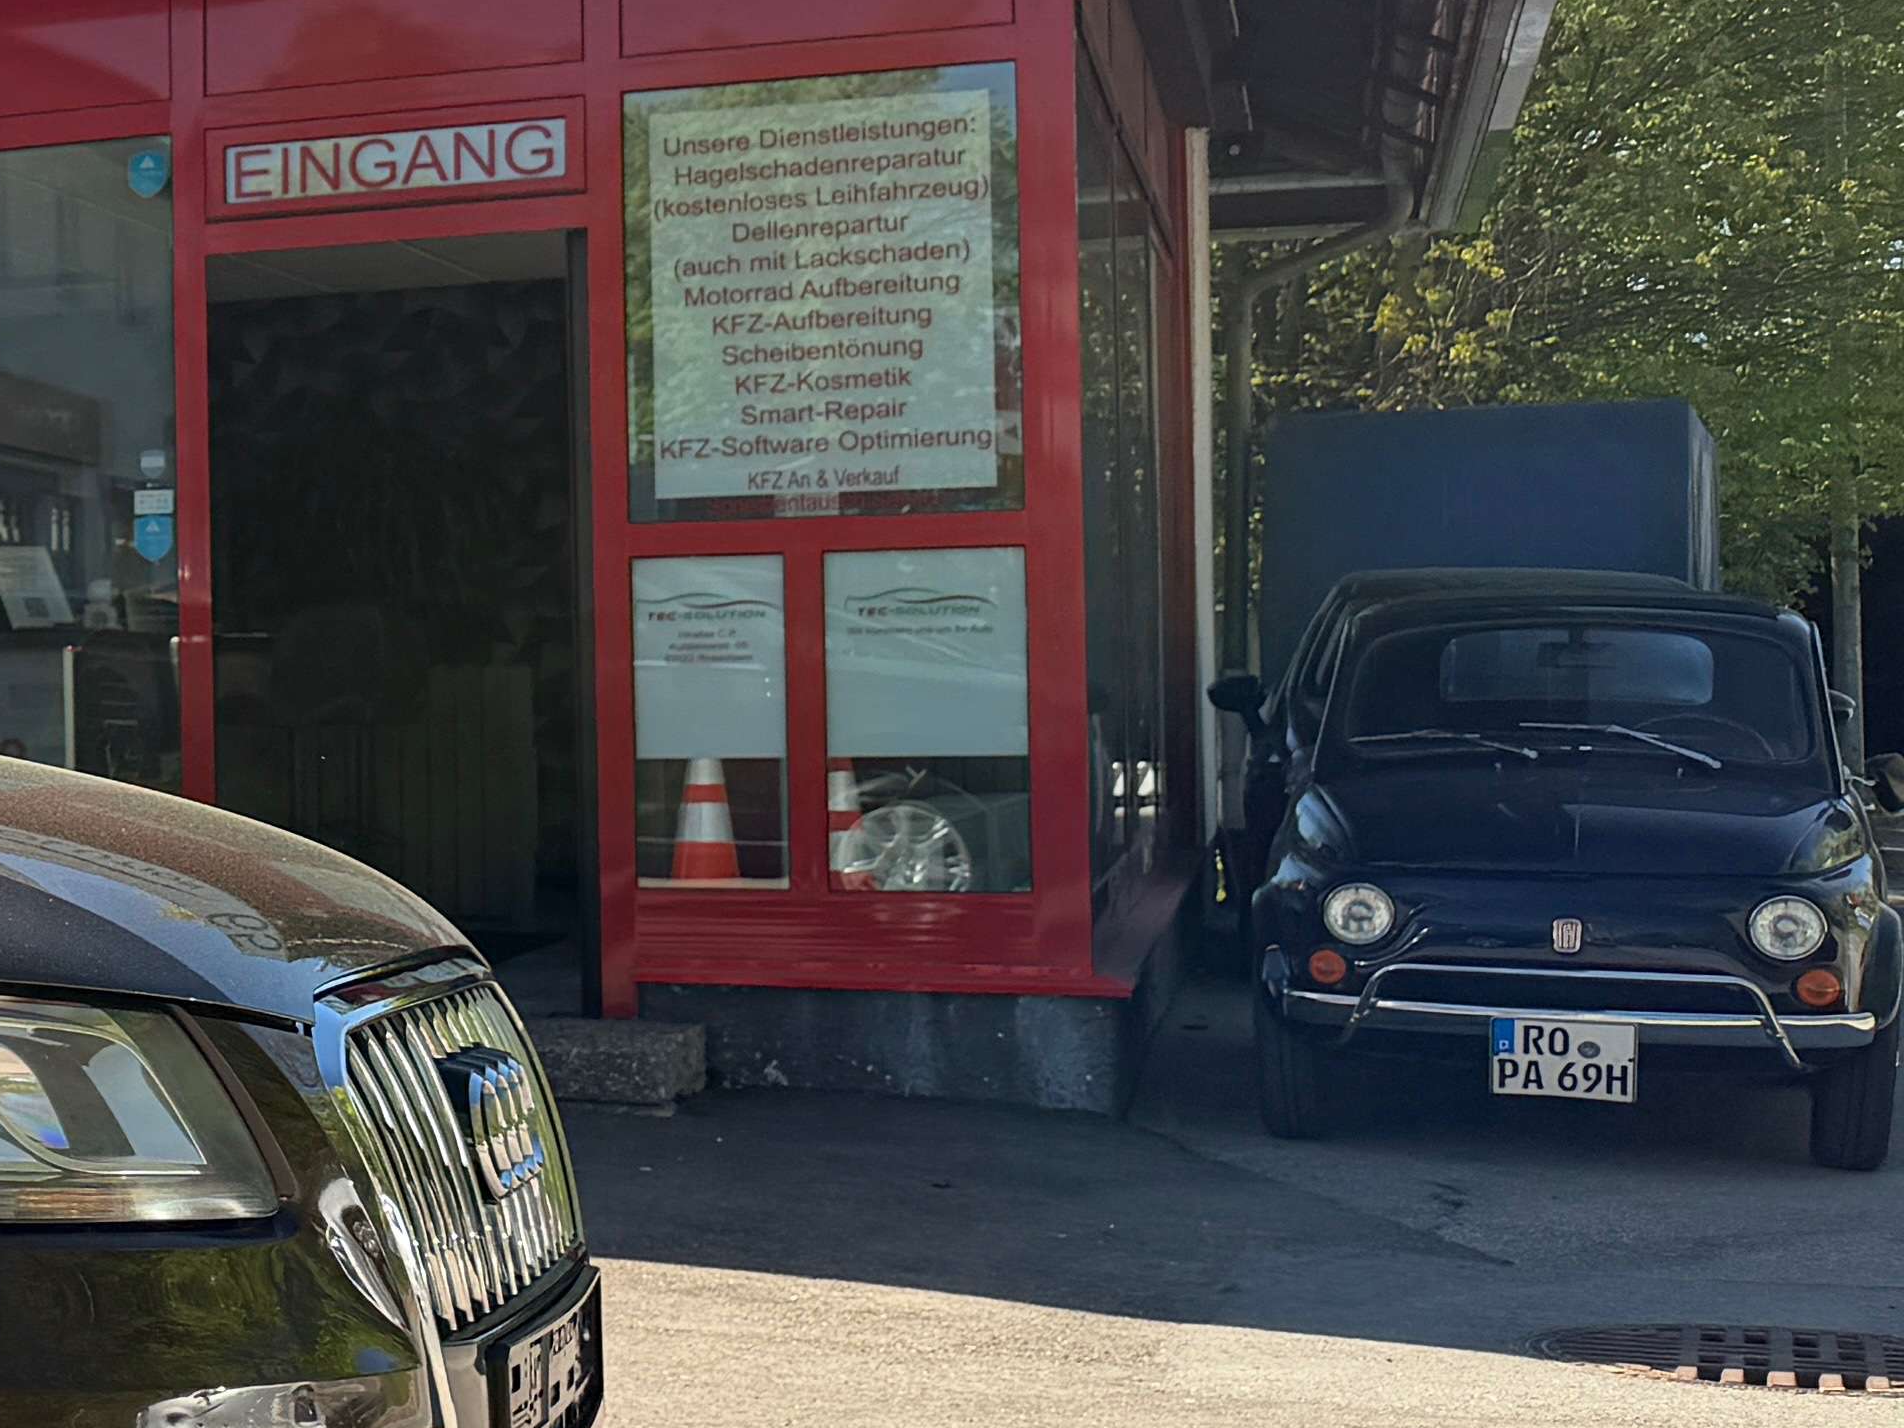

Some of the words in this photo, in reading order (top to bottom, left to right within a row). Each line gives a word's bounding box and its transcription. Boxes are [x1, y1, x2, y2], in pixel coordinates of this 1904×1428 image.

[662, 135, 750, 158] Unsere
[759, 115, 977, 151] Dienstleistungen:
[233, 123, 556, 201] EINGANG
[674, 147, 968, 189] Hagelschadenreparatur
[653, 190, 808, 222] (kostenloses
[816, 175, 990, 208] Leihfahrzeug)
[731, 213, 910, 244] Dellenrepartur
[673, 253, 741, 284] (auch
[749, 249, 787, 274] mit
[795, 237, 972, 271] Lackschaden)
[683, 280, 794, 308] Motorrad
[799, 273, 962, 301] Aufbereitung
[712, 305, 934, 336] KFZ-Aufbereitung
[721, 337, 925, 367] Scheibentönung
[733, 366, 913, 397] KFZ-Kosmetik
[740, 398, 908, 426] Smart-Repair
[659, 432, 831, 461] KFZ-Software
[837, 427, 993, 453] Optimierung
[747, 470, 785, 491] KFZ
[786, 468, 812, 490] An
[816, 469, 829, 487] &
[833, 464, 901, 488] Verkauf
[1498, 1039, 1510, 1050] D
[1522, 1025, 1570, 1056] RO
[1496, 1058, 1545, 1090] PA
[1557, 1061, 1629, 1096] 69H
